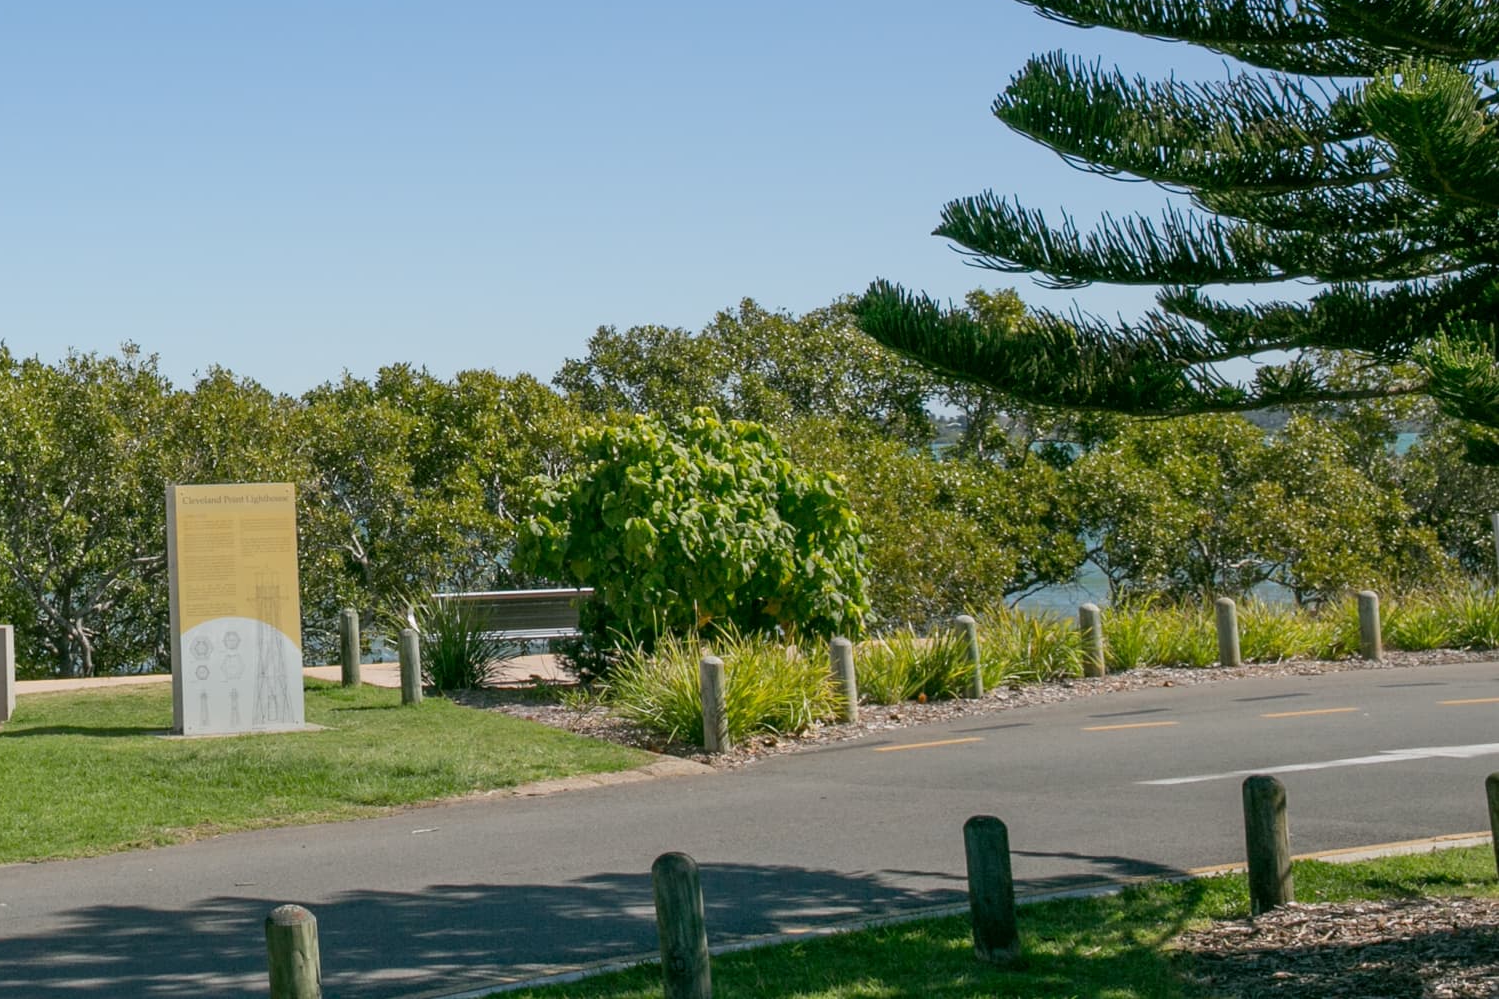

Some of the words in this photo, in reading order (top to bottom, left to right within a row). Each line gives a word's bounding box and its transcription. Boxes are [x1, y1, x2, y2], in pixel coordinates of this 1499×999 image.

[182, 495, 221, 505] Cleveland
[224, 495, 244, 504] Point
[246, 494, 288, 505] Lighthouse
